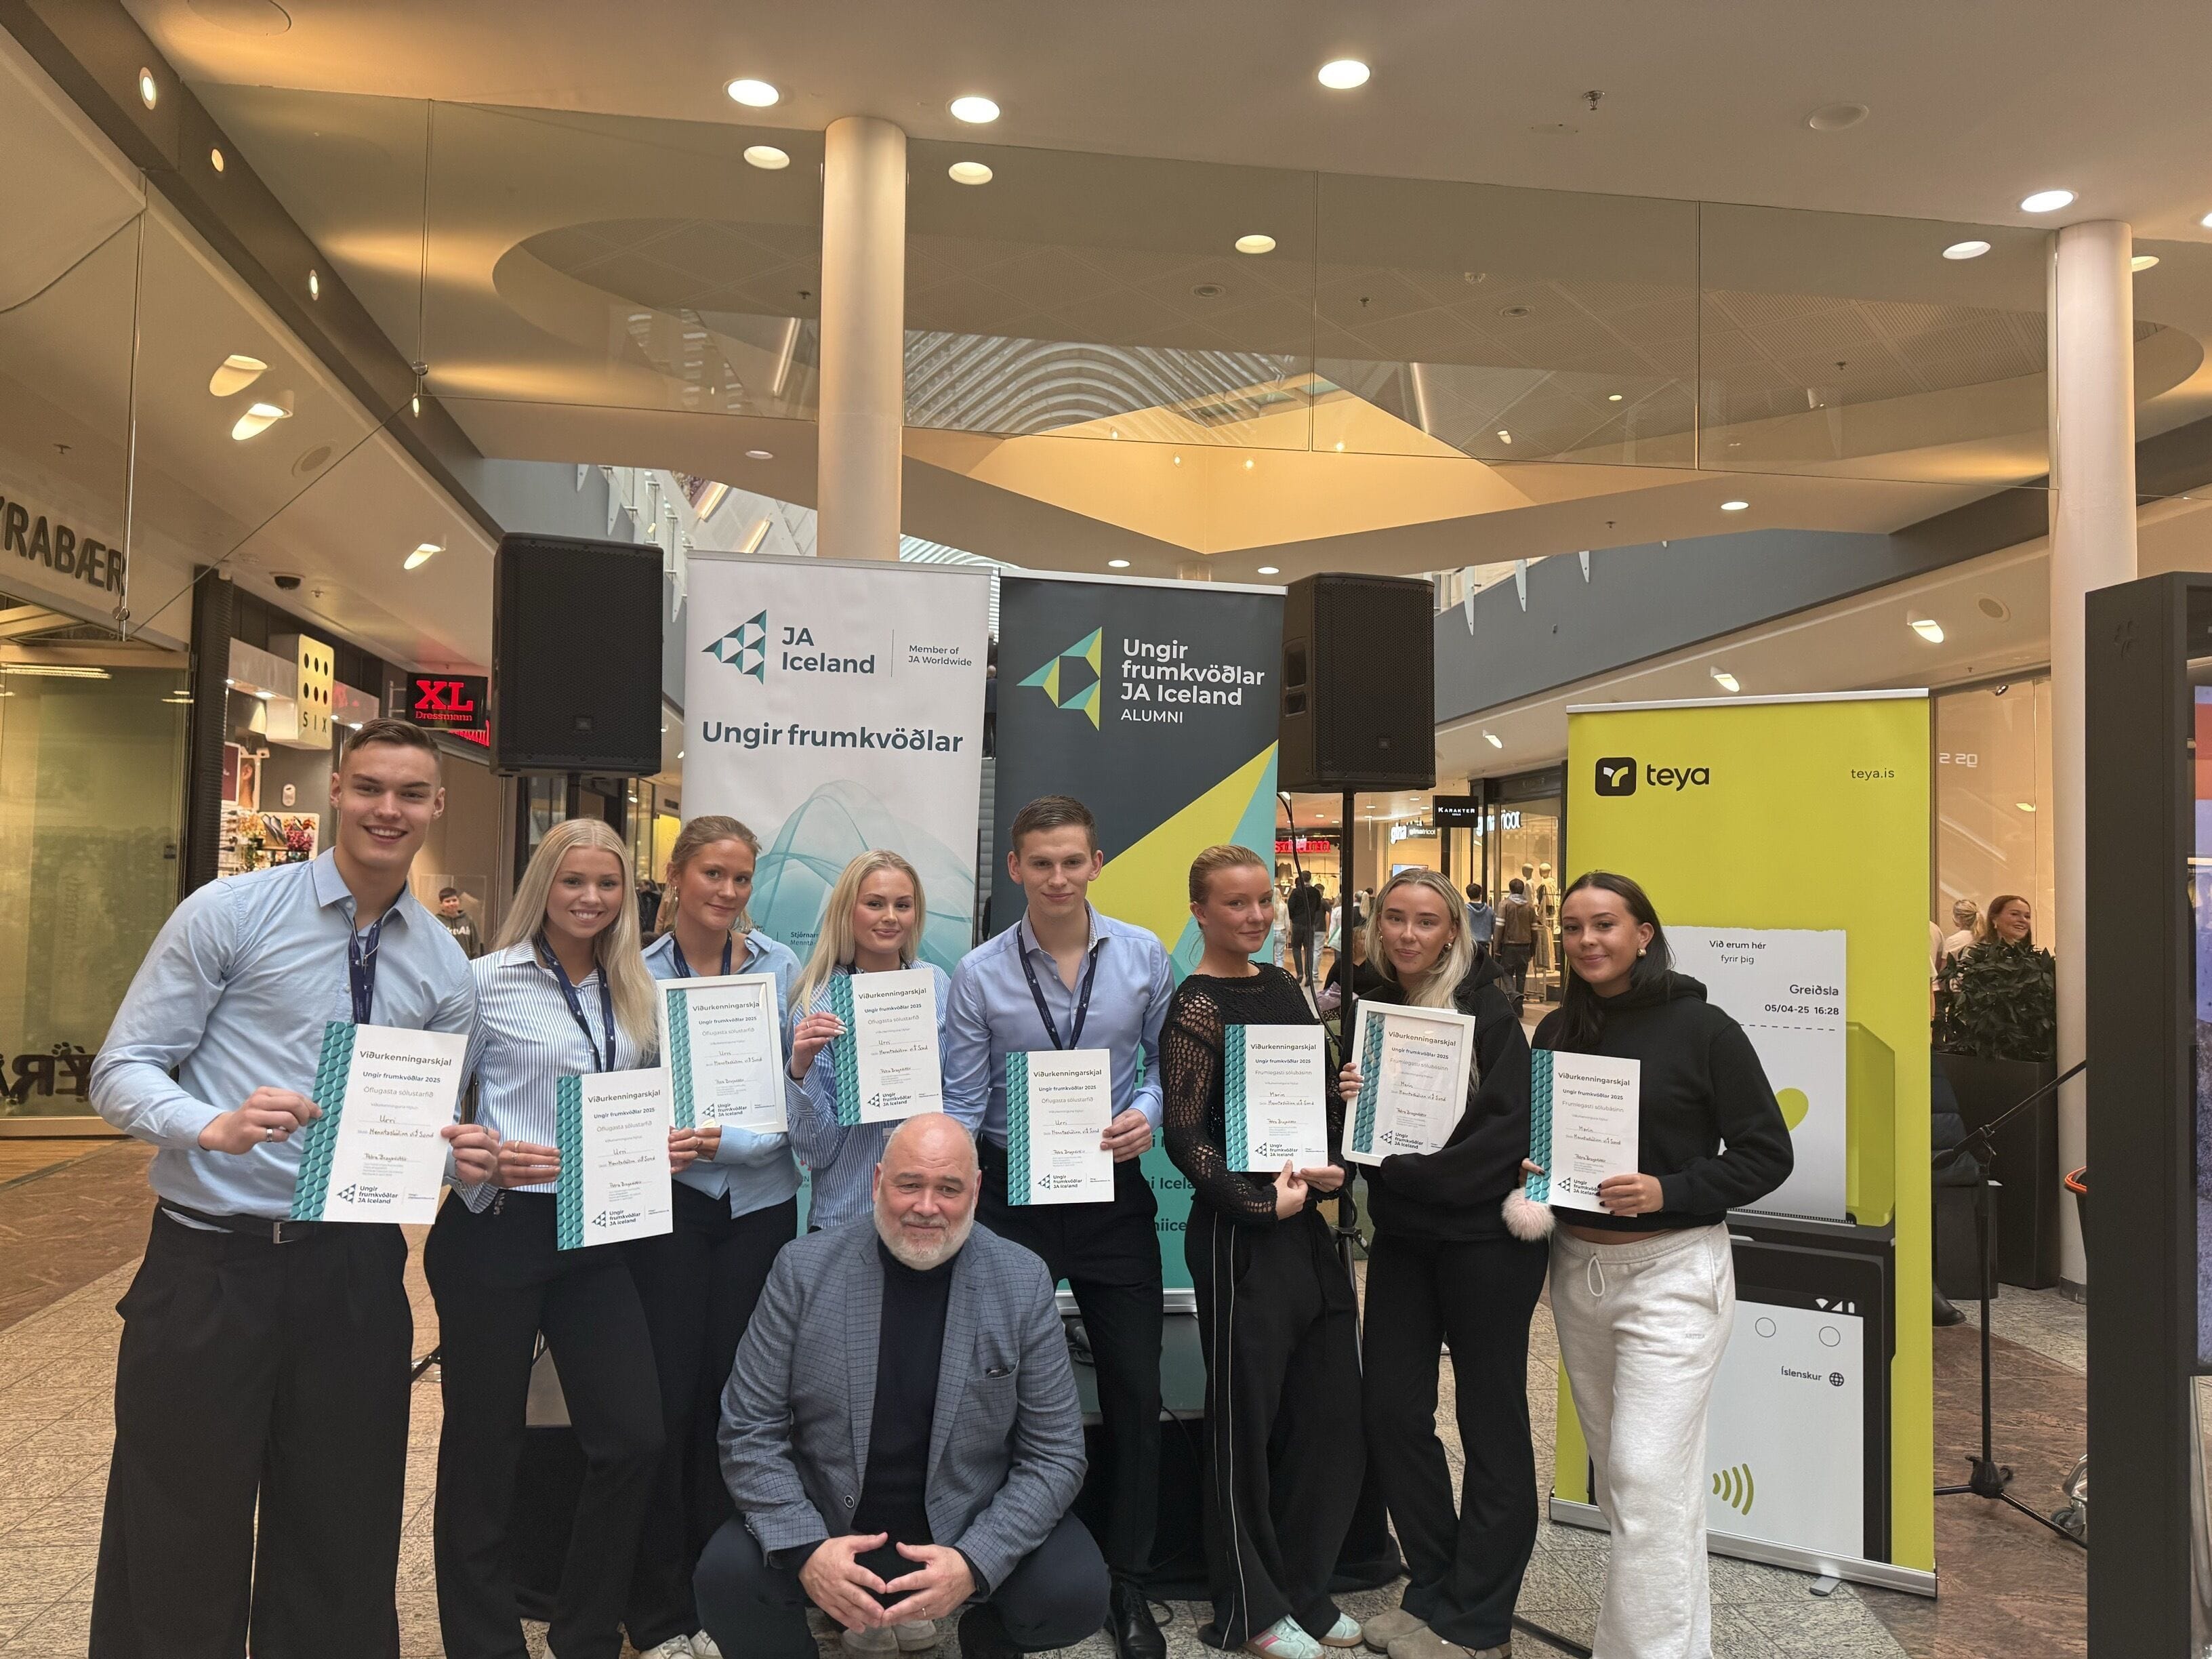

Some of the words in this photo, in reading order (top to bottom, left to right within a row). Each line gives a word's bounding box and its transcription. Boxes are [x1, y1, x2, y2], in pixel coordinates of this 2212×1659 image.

[0, 495, 126, 597] RABÆR
[781, 627, 815, 647] JA
[909, 644, 948, 654] Member
[950, 646, 959, 655] of
[1124, 638, 1188, 662] Ungir
[781, 651, 876, 674] Iceland
[922, 656, 972, 666] Worldwide
[1122, 660, 1265, 685] frumkvöðlar
[415, 680, 474, 712] XL
[1120, 682, 1151, 701] JA
[1158, 684, 1242, 705] Iceland
[415, 712, 472, 721] Dressmann
[1120, 709, 1183, 723] ALUMNI
[703, 721, 783, 750] Ungir
[787, 724, 964, 752] frumkvöðlar
[1646, 764, 1710, 792] teya
[1851, 768, 1895, 781] teya.is
[1709, 940, 1724, 948] Við
[1721, 955, 1738, 964] fyrir
[1740, 955, 1754, 964] þig
[859, 988, 926, 999] Viðurkenningarskjal
[1789, 984, 1839, 996] Greiðsla
[693, 1001, 759, 1011] Viðurkenningarskja
[1765, 1004, 1809, 1013] 05/04-25
[1814, 1007, 1839, 1015] 16:28
[360, 1051, 451, 1067] Viðurkenningarskjal
[1558, 1072, 1630, 1086] Viðurkenningarskjal
[588, 1090, 661, 1103] Viðurkenningarskjal
[1160, 1176, 1196, 1189] Icela
[1781, 1366, 1822, 1381] Íslenskur
